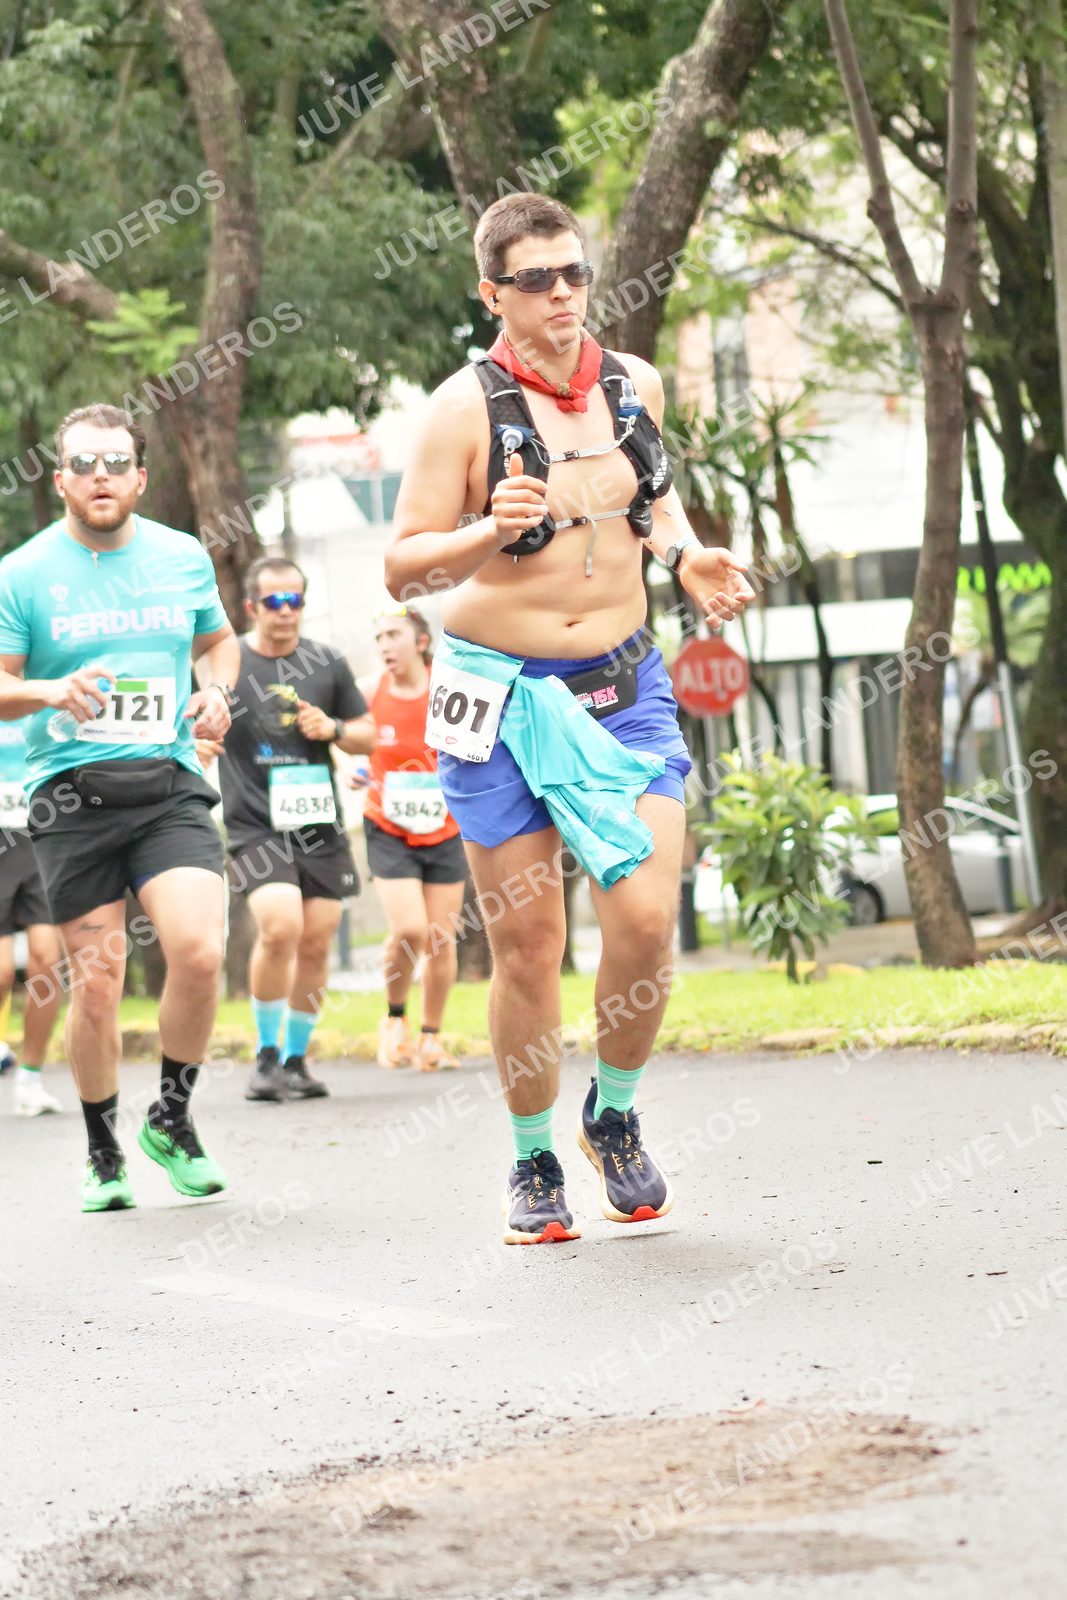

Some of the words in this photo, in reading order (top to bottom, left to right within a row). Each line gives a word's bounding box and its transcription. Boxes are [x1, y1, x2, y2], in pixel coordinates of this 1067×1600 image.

[51, 604, 189, 640] PERDURA
[680, 659, 744, 693] ALTO
[96, 695, 164, 721] 121
[429, 685, 490, 734] 601
[592, 685, 617, 705] 15K
[391, 801, 443, 818] 3842
